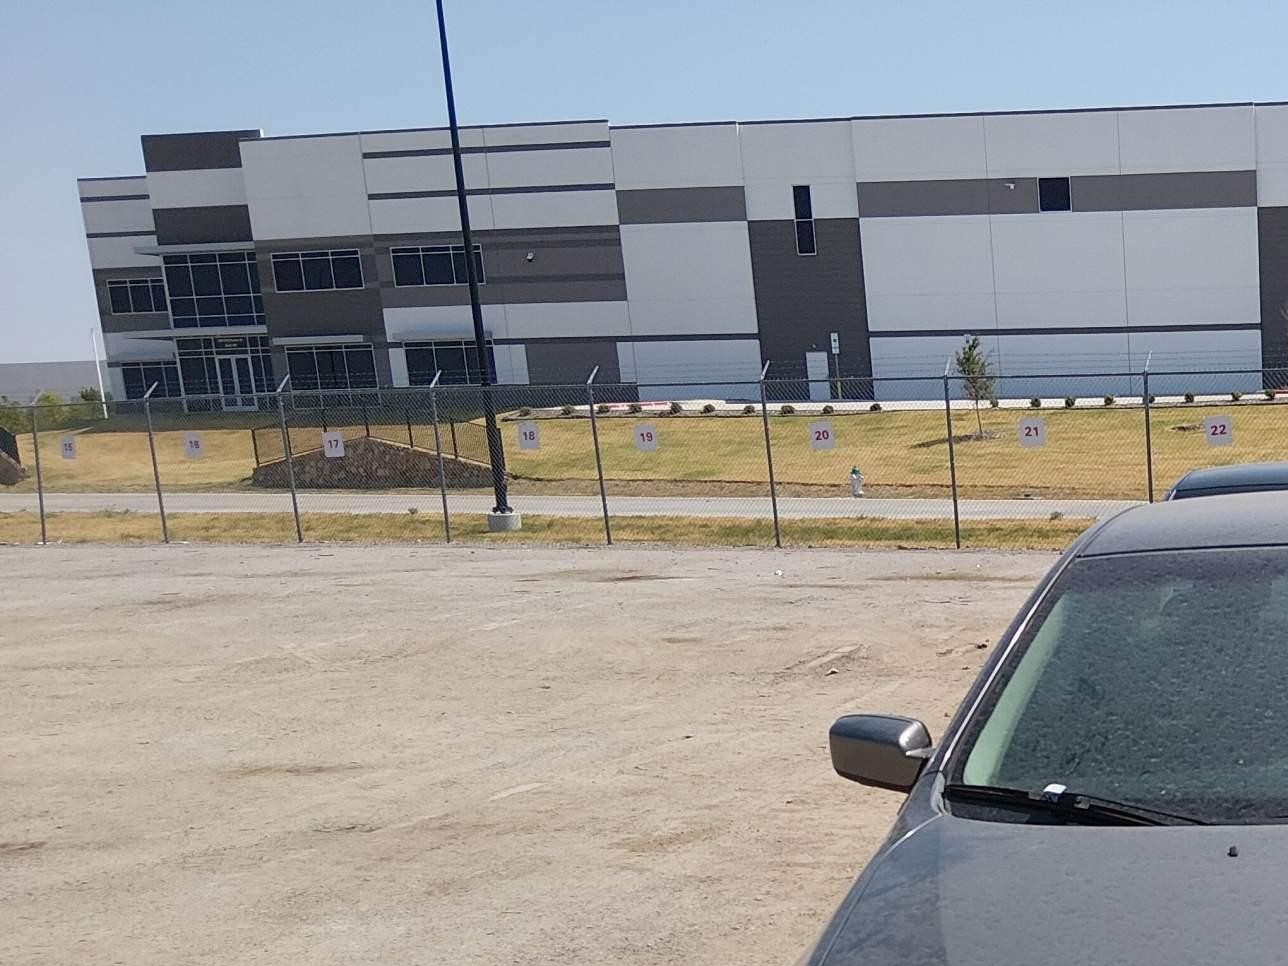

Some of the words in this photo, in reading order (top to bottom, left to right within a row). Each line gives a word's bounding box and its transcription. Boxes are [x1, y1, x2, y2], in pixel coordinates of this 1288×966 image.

[815, 430, 829, 441] 20
[1025, 426, 1039, 437] 21
[1211, 424, 1226, 436] 22
[523, 432, 535, 441] 18
[640, 432, 653, 443] 19
[328, 439, 339, 448] 17
